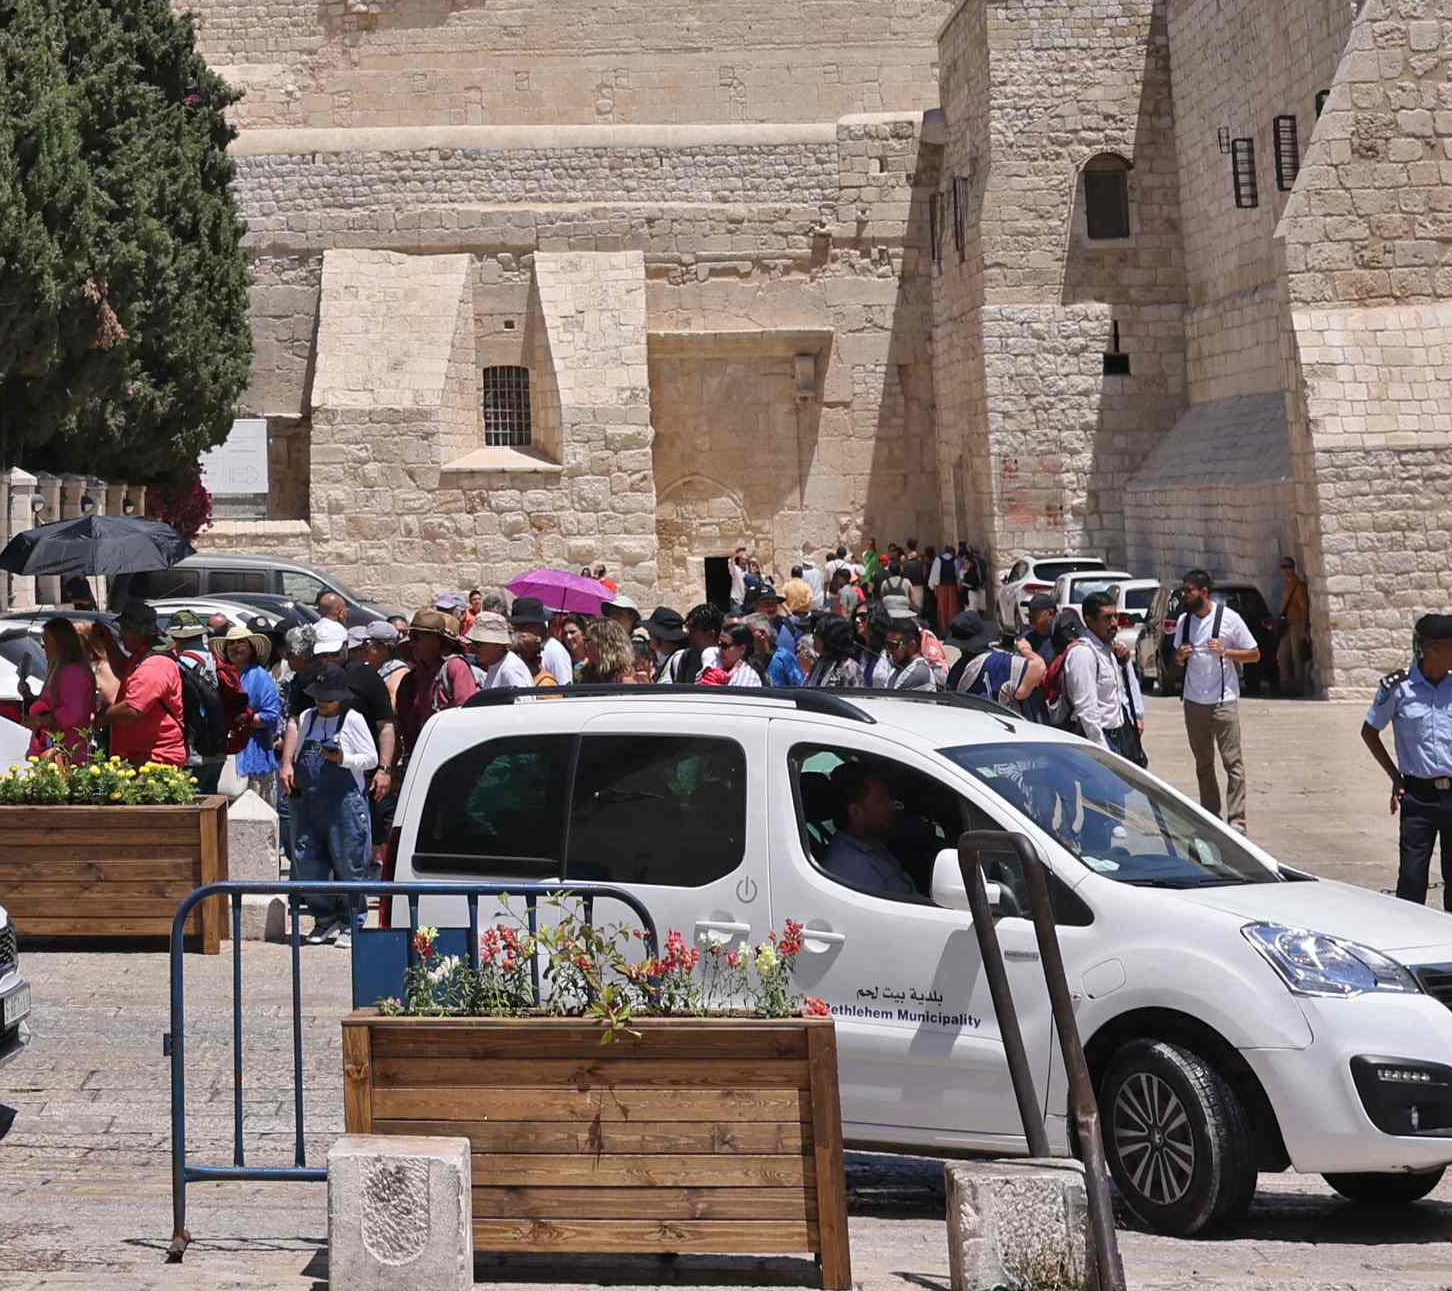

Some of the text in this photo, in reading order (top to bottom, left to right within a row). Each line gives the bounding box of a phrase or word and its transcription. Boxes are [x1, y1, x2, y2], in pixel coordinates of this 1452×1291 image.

[856, 985, 943, 1005] بلدية بيت لحم
[897, 1010, 981, 1029] Municipality
